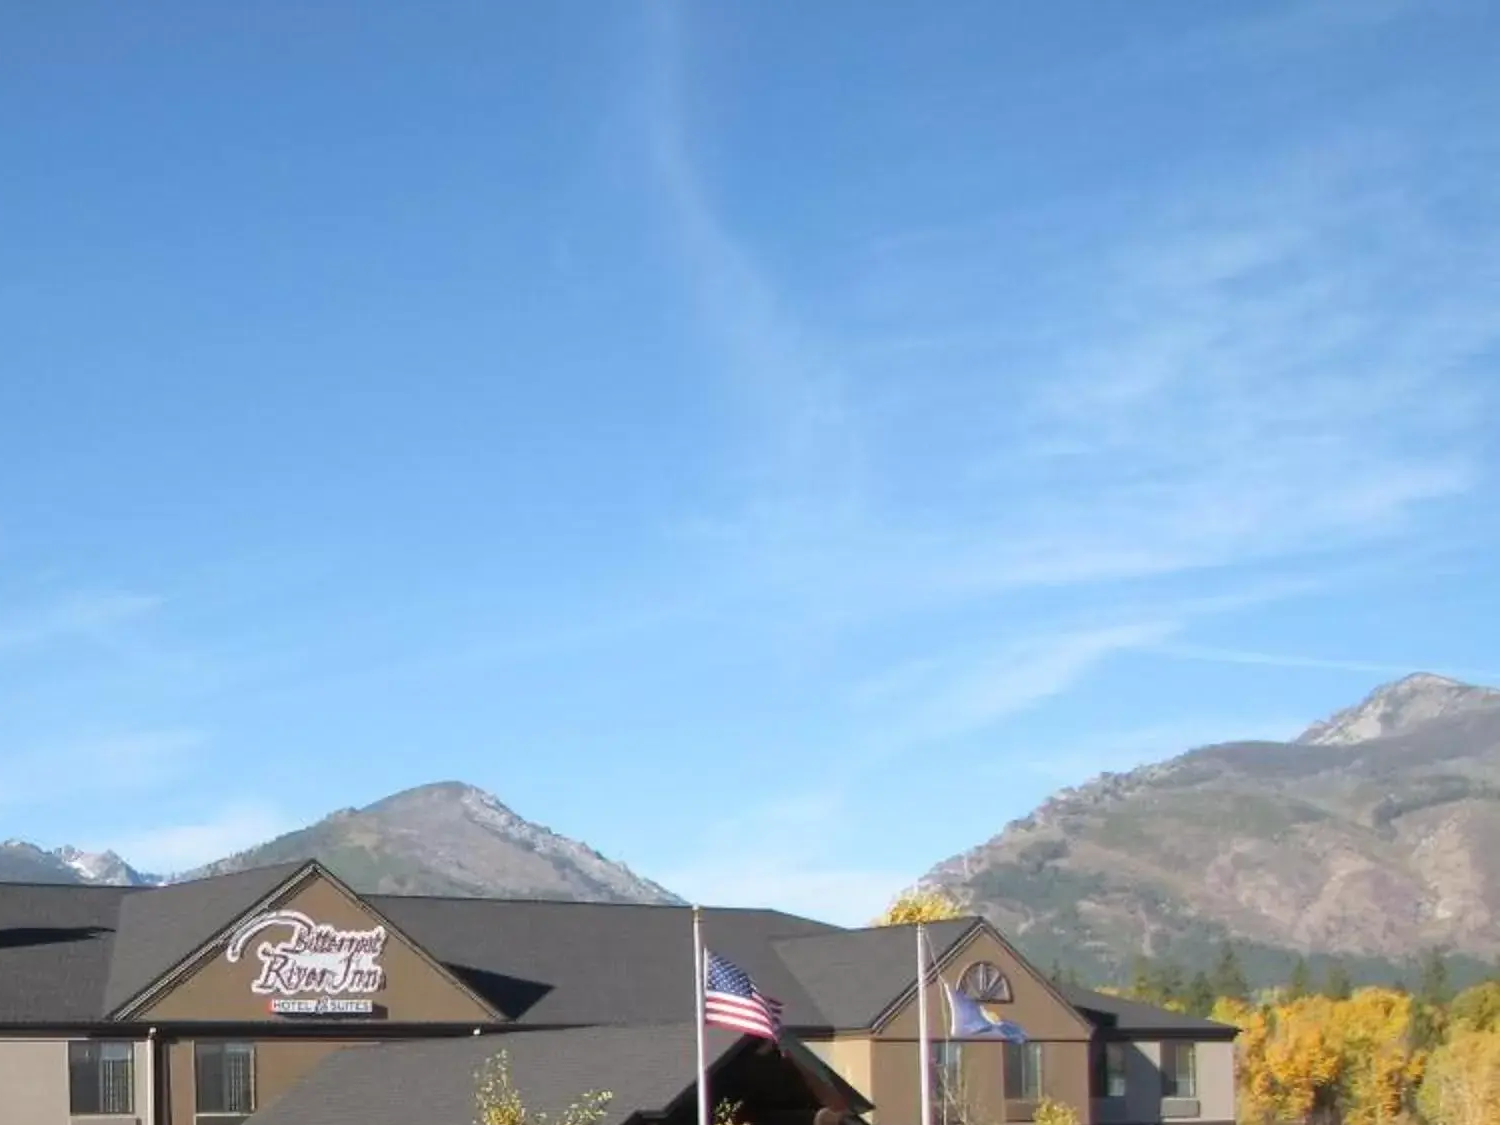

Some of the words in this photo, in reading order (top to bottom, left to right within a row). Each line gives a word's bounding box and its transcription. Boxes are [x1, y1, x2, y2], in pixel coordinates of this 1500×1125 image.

[260, 951, 326, 992] River
[328, 951, 380, 991] Inn
[272, 1000, 316, 1011] HOTEL
[331, 1000, 370, 1011] SUITES
